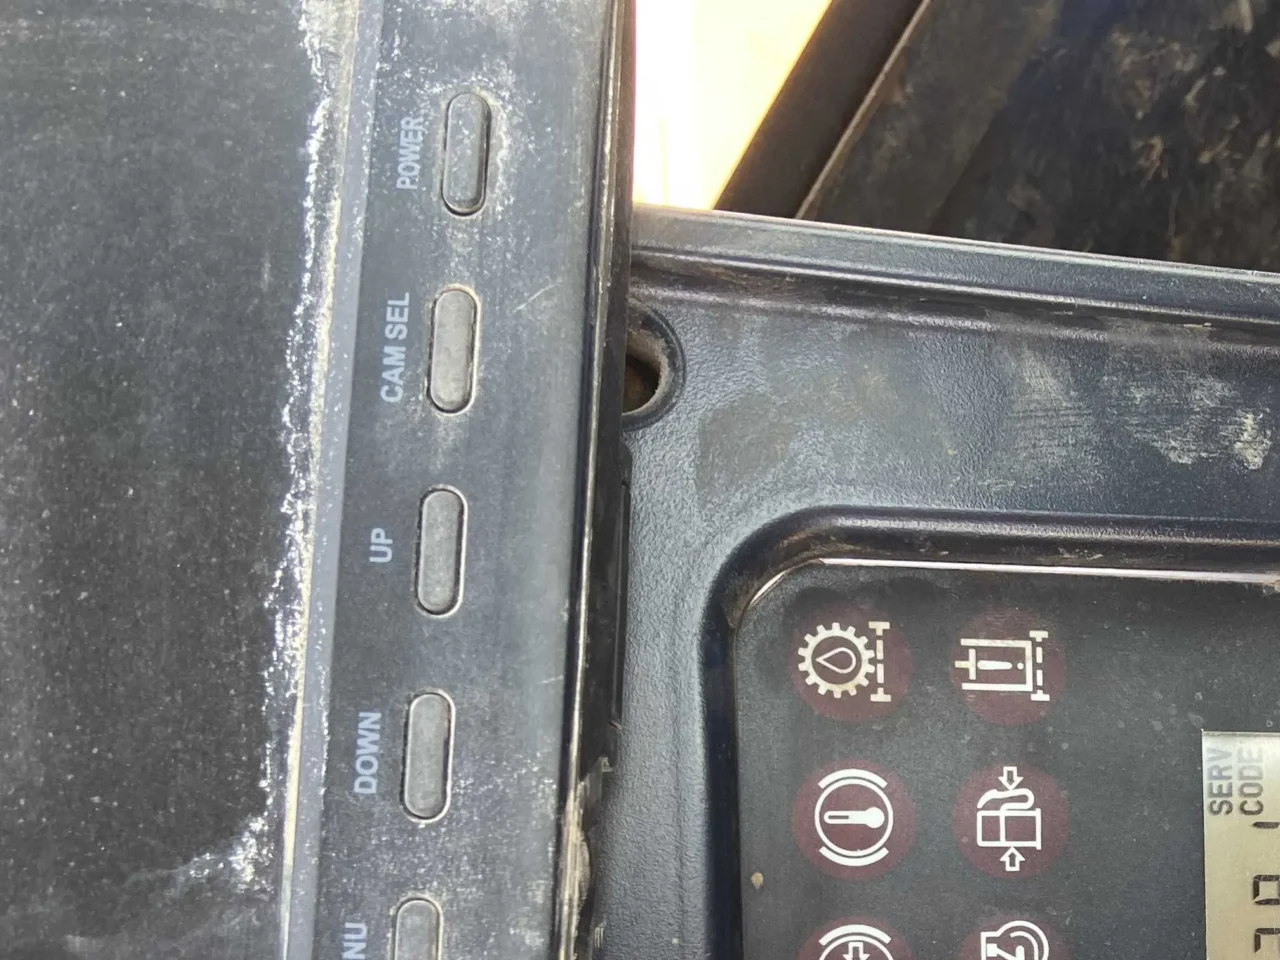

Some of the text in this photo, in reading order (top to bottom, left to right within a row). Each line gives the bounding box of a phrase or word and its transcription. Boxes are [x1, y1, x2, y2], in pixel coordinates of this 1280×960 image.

[396, 116, 424, 190] POWER
[380, 292, 410, 403] CAM SEL
[369, 527, 394, 563] UP
[354, 711, 382, 794] DOWN
[1207, 747, 1234, 816] SERV
[1237, 747, 1264, 816] CODE
